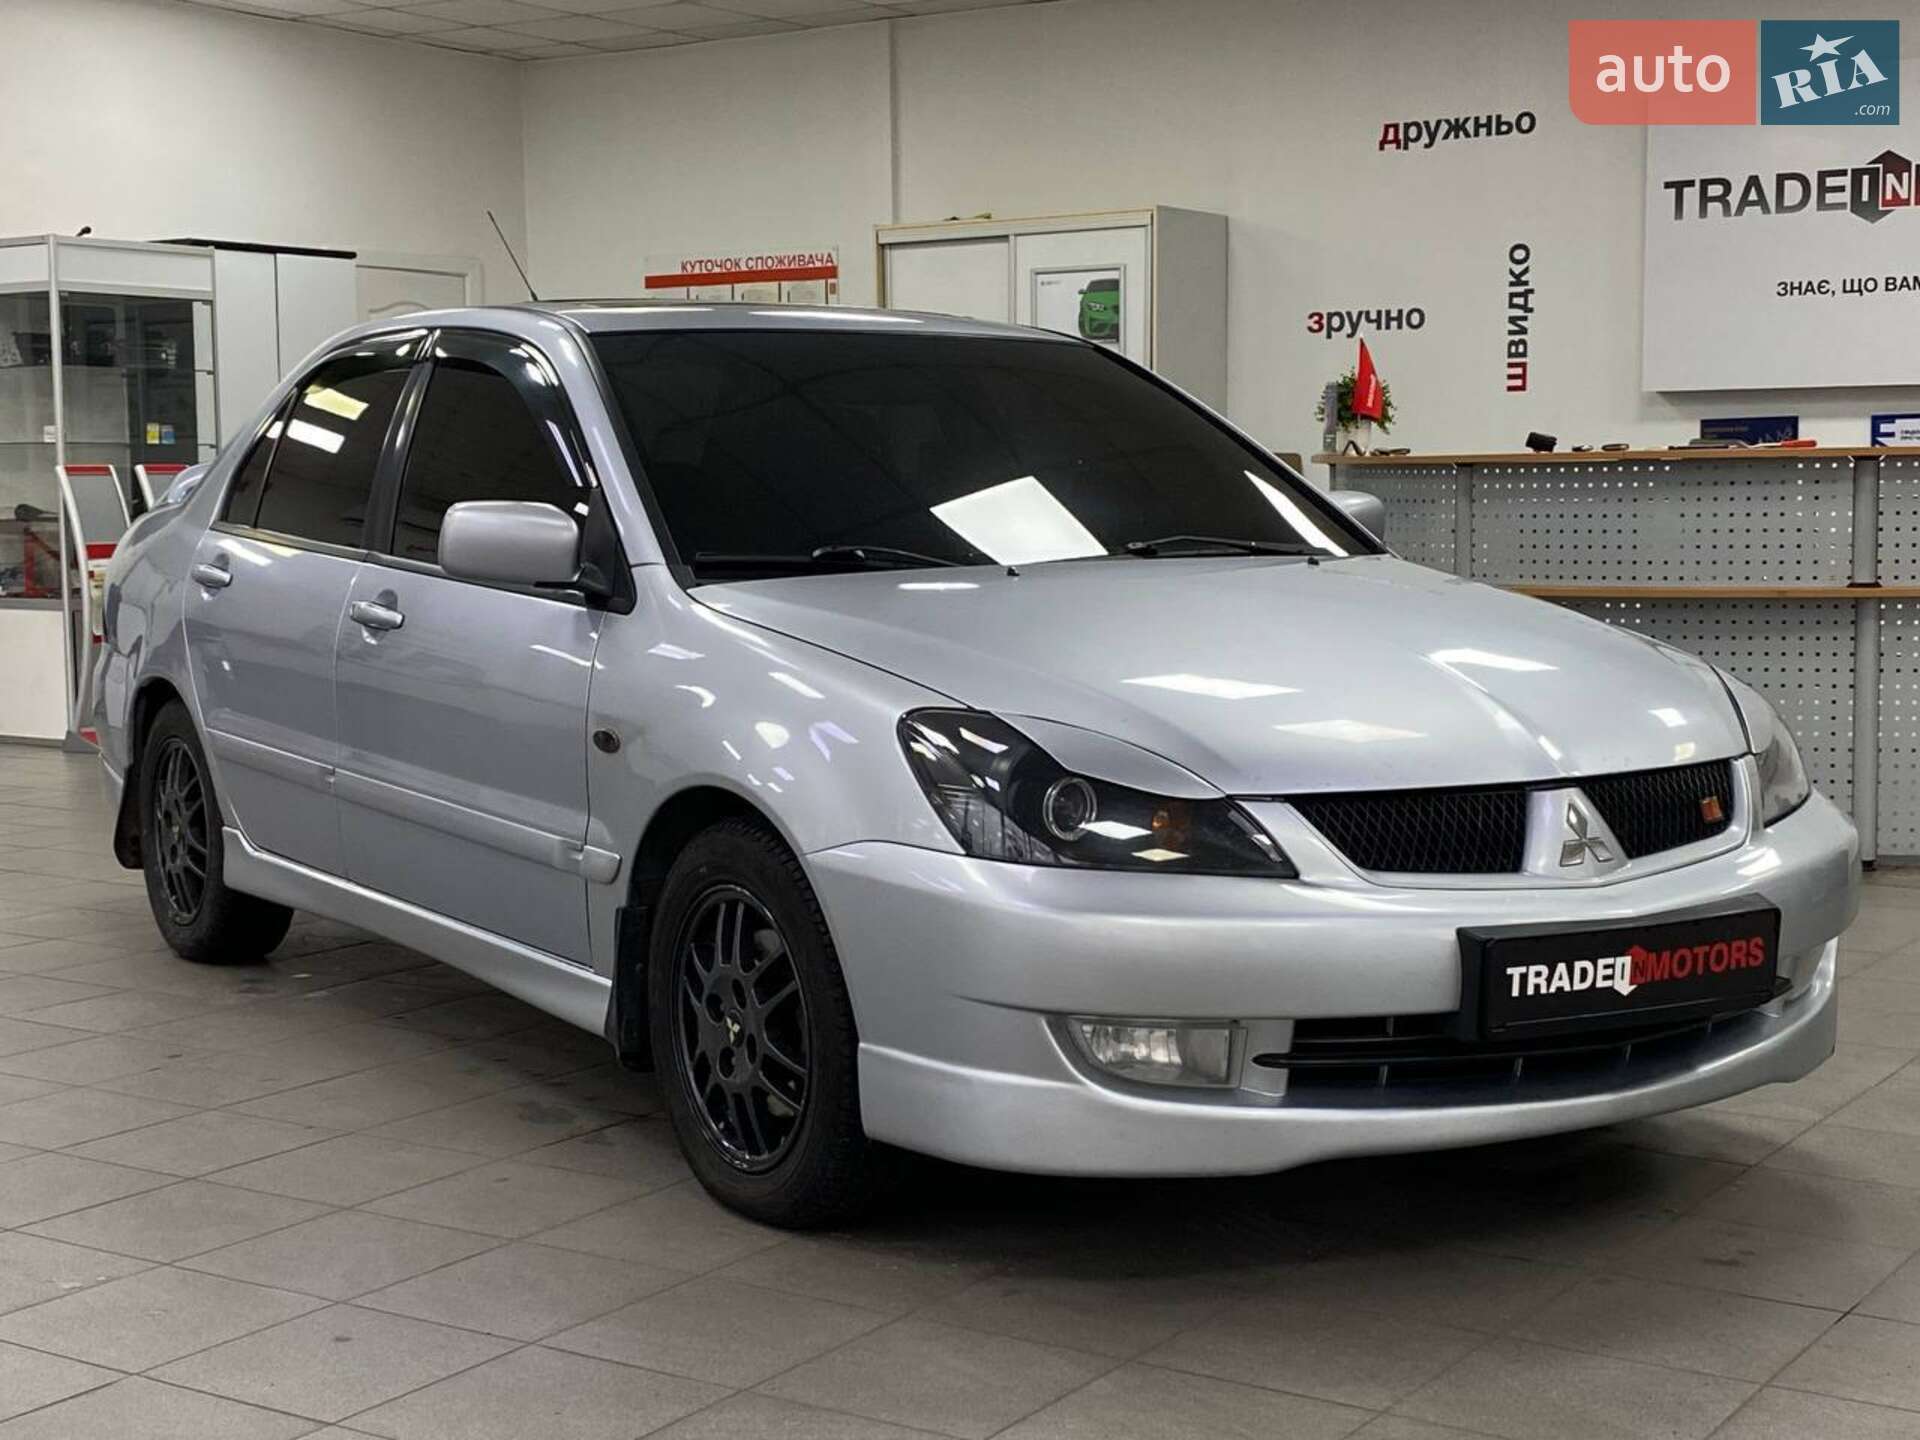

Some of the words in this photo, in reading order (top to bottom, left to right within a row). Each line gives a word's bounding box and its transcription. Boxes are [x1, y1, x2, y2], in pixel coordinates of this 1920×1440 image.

[1379, 111, 1537, 151] дружньо
[681, 256, 741, 273] КУТОЧОК
[745, 252, 835, 269] СПОЖИВАЧА
[1776, 279, 1836, 297] ЗНАЄ,
[1842, 277, 1878, 296] ЩО
[1307, 307, 1426, 339] зручно
